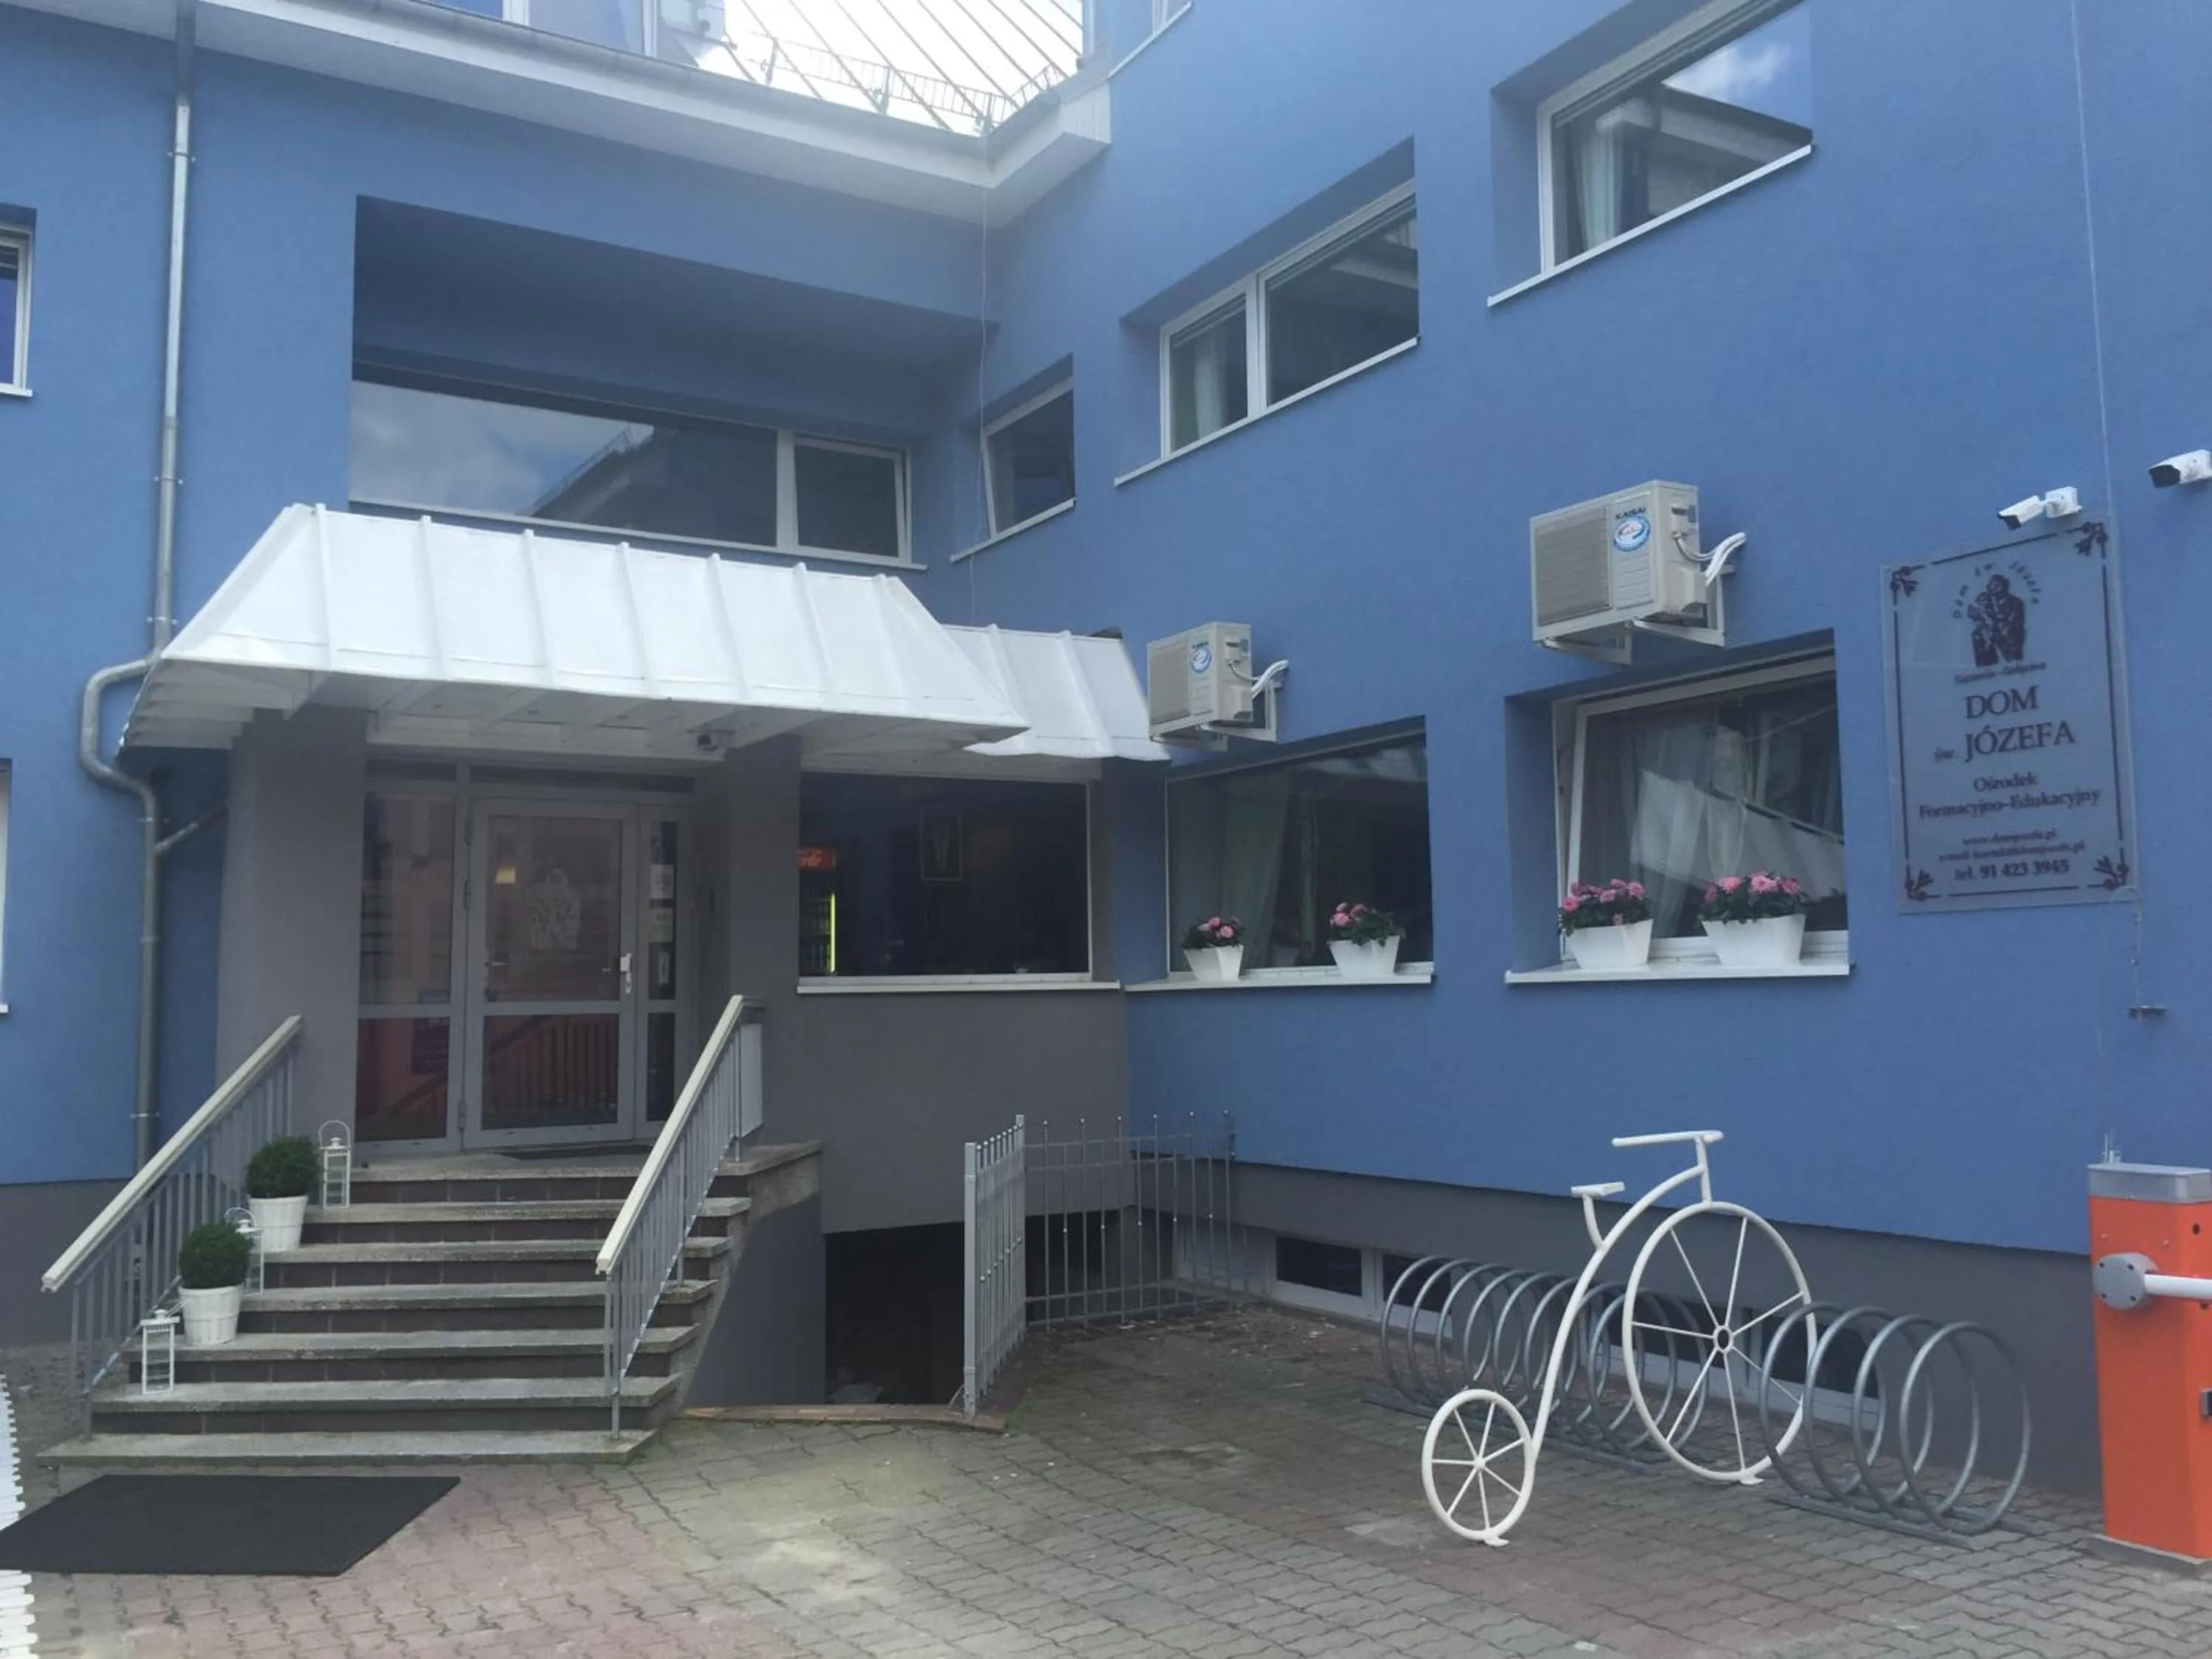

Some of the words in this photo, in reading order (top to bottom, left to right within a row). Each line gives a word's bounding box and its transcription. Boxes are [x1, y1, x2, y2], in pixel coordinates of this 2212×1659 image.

[1965, 685, 2040, 720] DOM
[1964, 719, 2076, 762] JÓZEFA
[1972, 771, 2039, 793] Ośrodek
[1980, 864, 1997, 879] 91
[2002, 862, 2028, 877] 423
